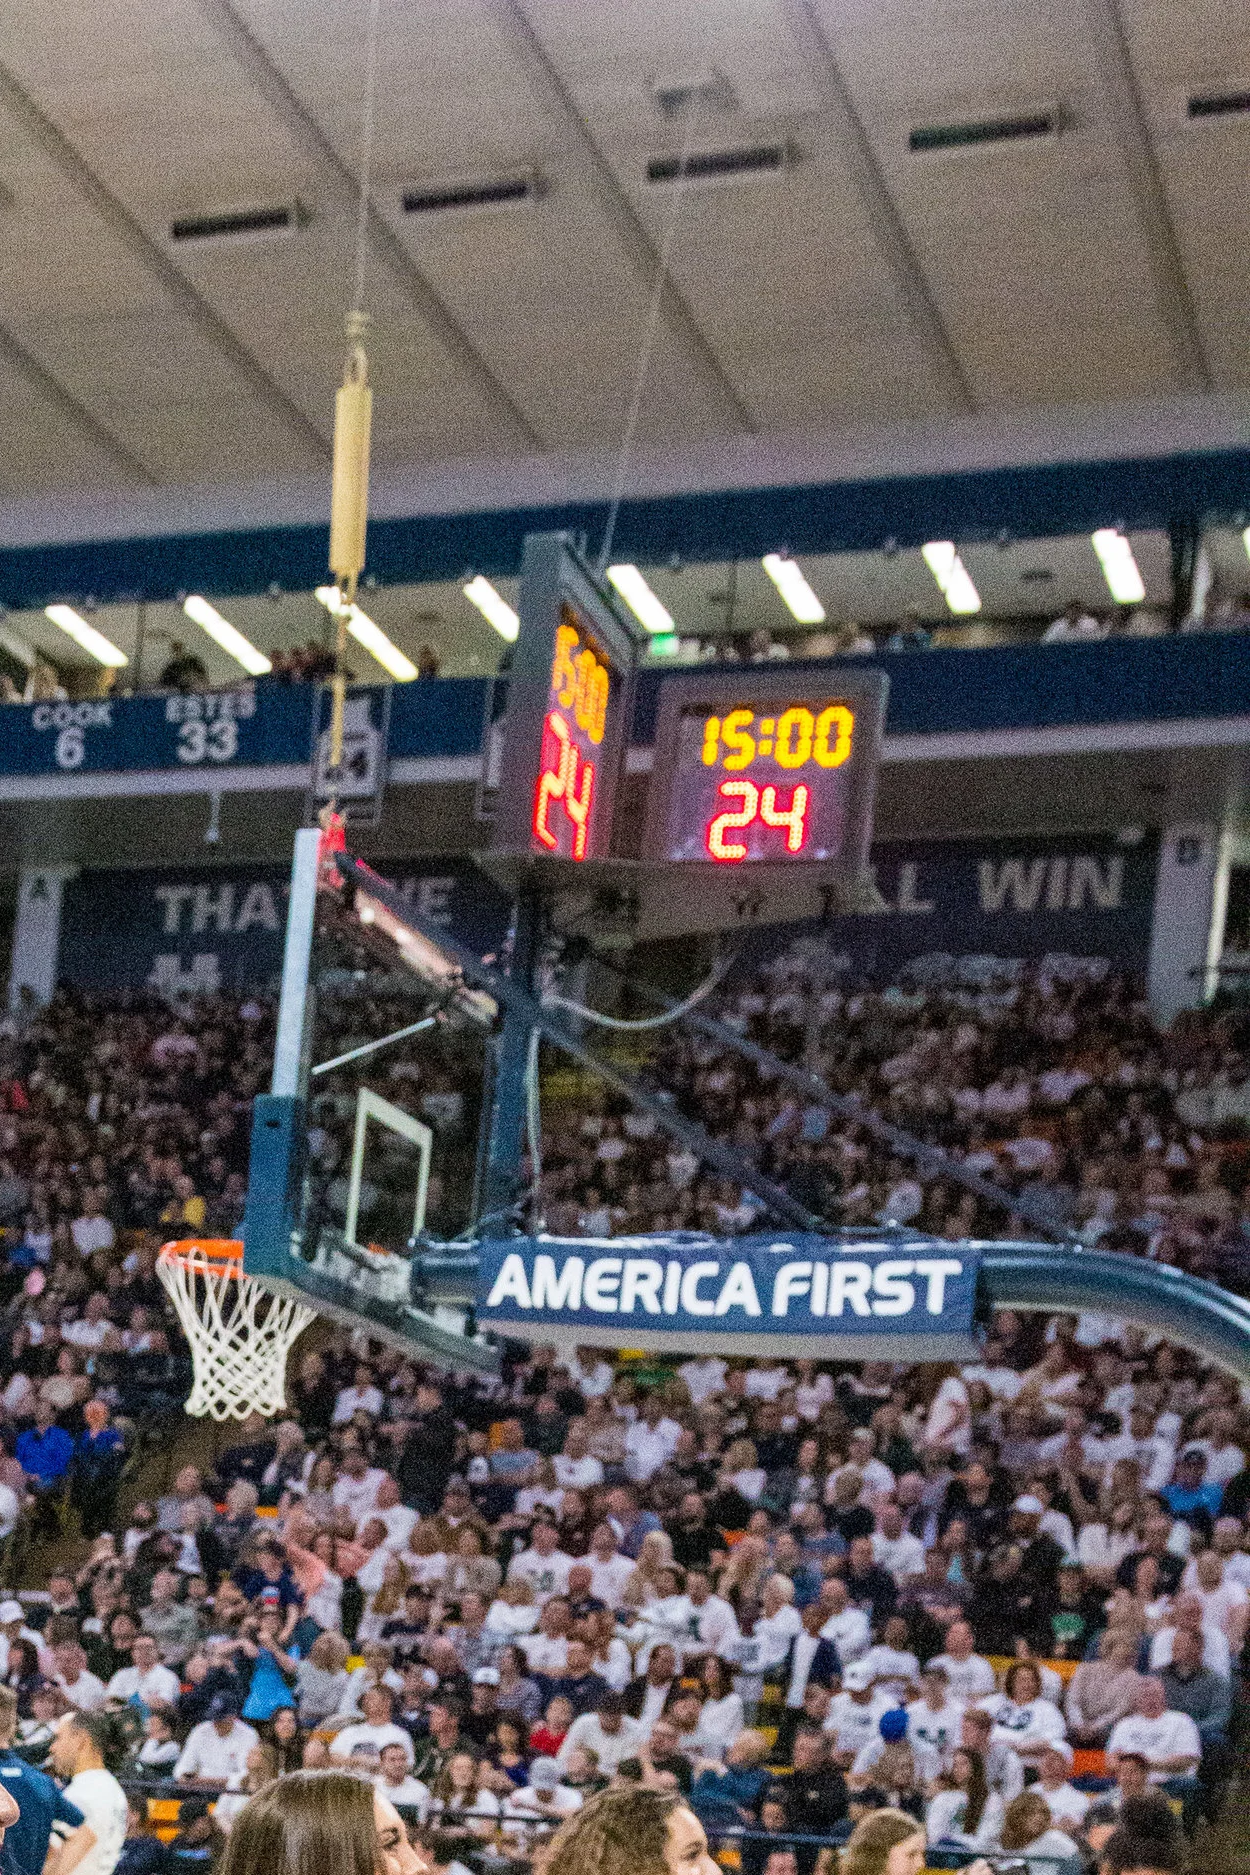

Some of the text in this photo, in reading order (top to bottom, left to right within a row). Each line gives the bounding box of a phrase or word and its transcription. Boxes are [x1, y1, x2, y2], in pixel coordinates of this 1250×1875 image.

[32, 702, 114, 733] COOK
[177, 719, 239, 764] 33
[701, 705, 855, 771] 15:00
[55, 727, 85, 769] 6
[707, 780, 809, 862] 24
[155, 882, 281, 932] THA
[978, 854, 1125, 912] WIN
[487, 1253, 963, 1317] AMERICA FIRST
